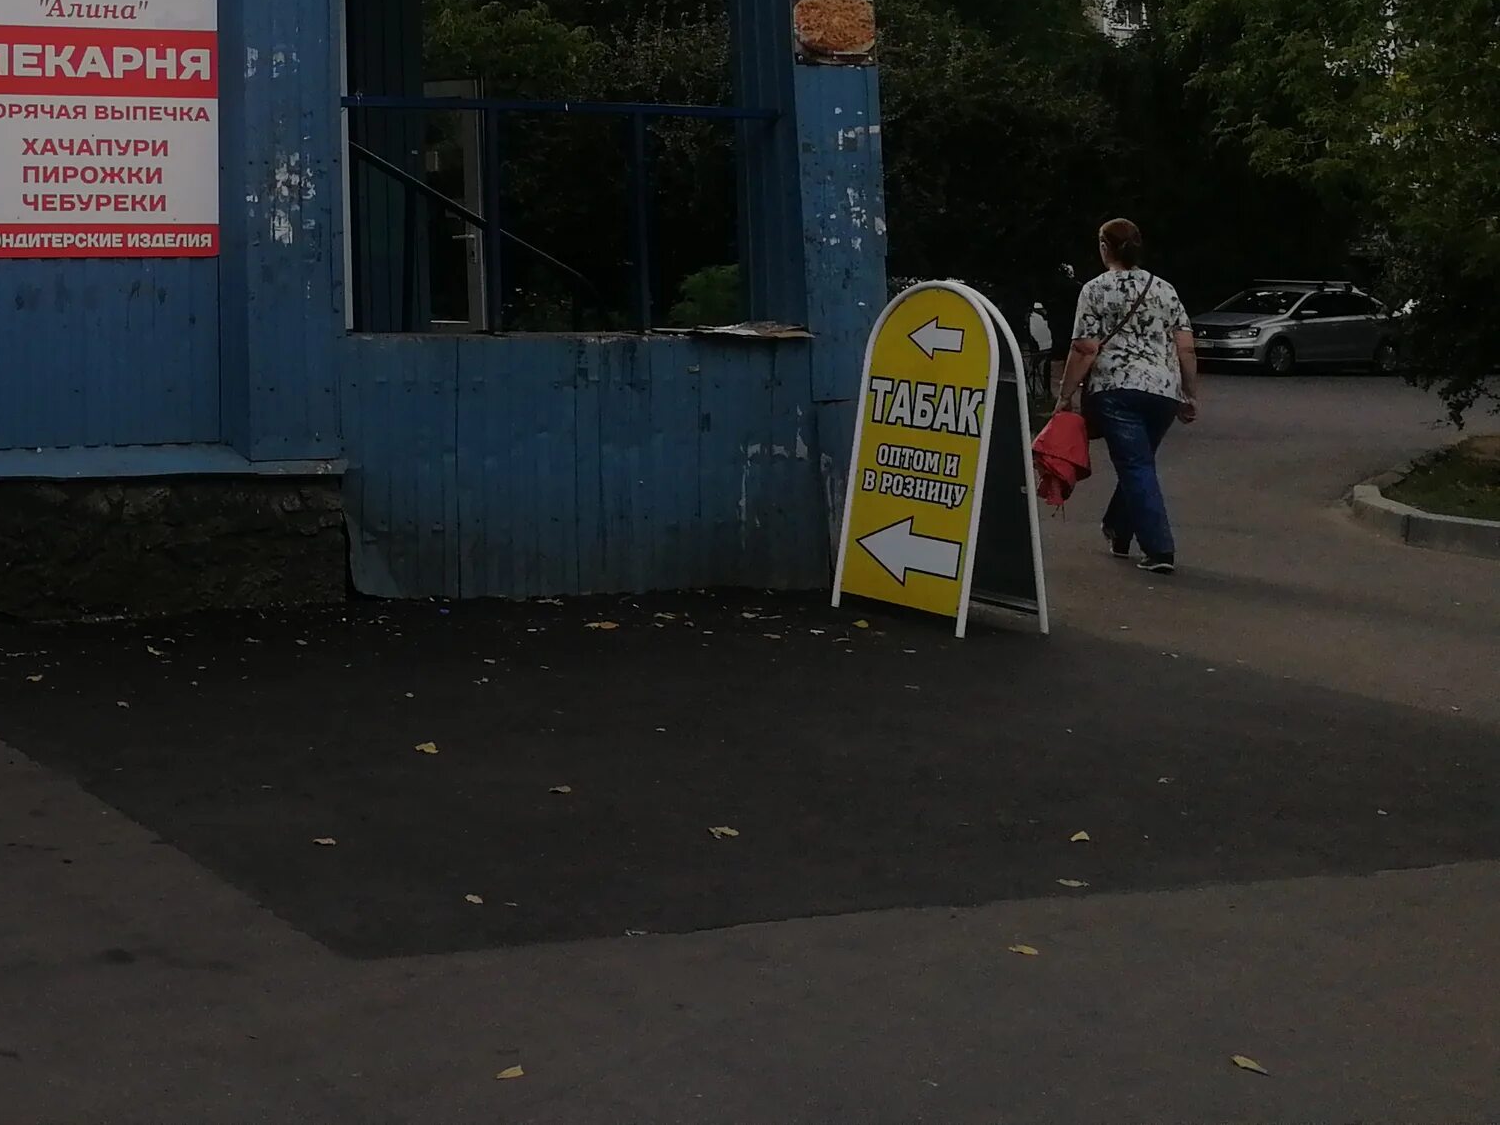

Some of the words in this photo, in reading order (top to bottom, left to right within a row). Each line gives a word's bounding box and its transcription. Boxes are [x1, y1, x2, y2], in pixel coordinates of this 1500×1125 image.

[94, 105, 211, 123] ВЫПЕЧКА
[22, 138, 169, 157] ХАЧАПУРИ
[22, 165, 163, 185] ПИРОЖКИ
[22, 193, 167, 212] ЧЕБУРЕКИ
[127, 233, 212, 249] ИЗДЕЛИЯ
[870, 377, 985, 438] ТАБАК
[876, 444, 941, 474] ОПТОМ
[943, 454, 960, 477] И
[862, 469, 877, 491] В
[880, 472, 967, 508] РОЗНИЦУ
